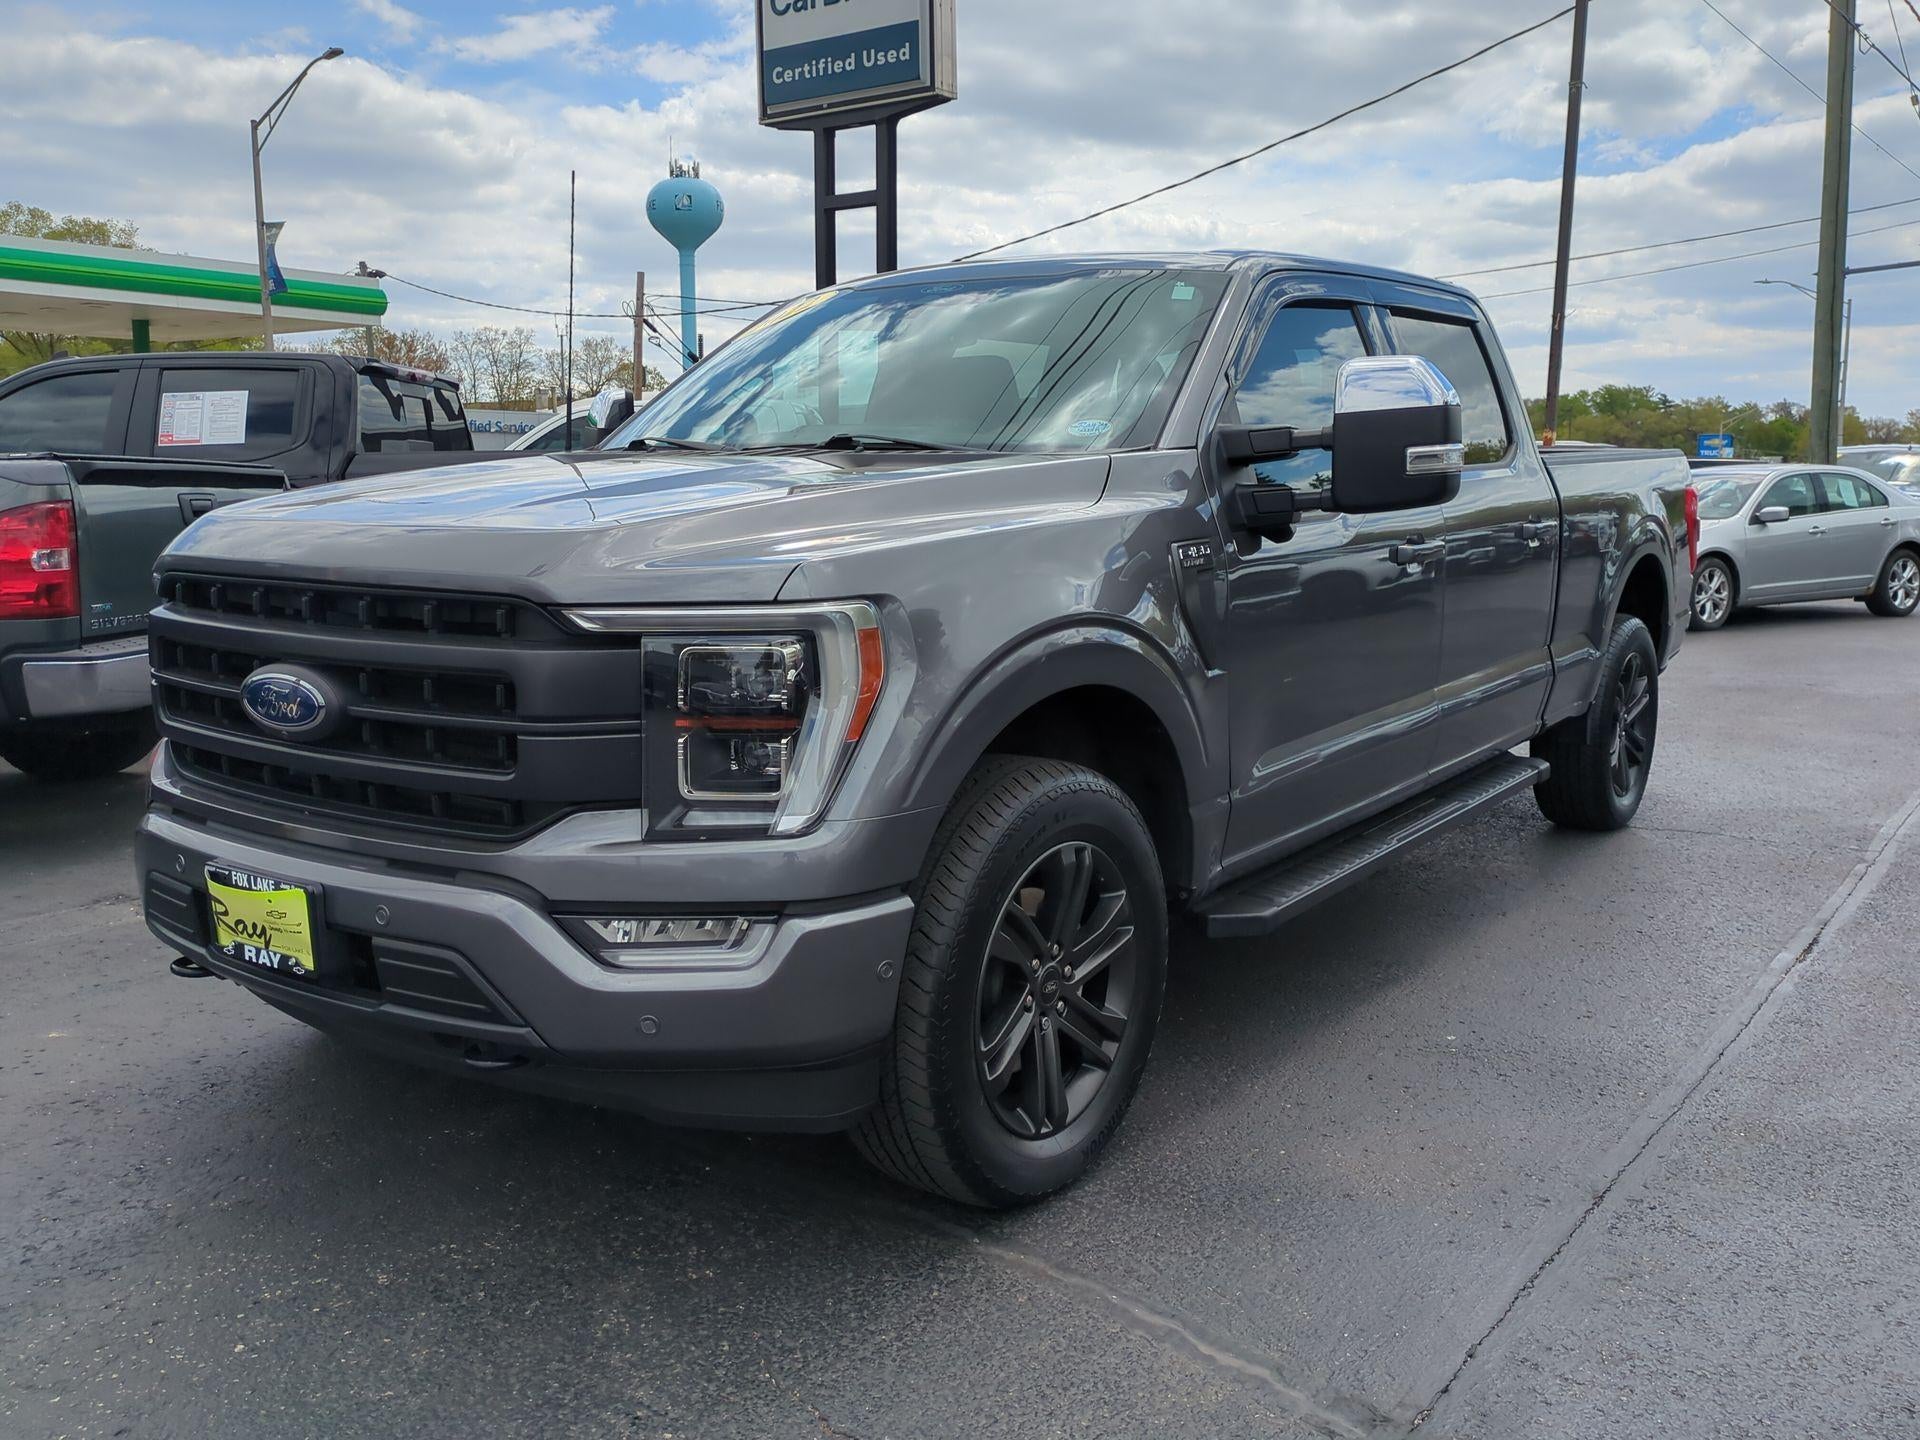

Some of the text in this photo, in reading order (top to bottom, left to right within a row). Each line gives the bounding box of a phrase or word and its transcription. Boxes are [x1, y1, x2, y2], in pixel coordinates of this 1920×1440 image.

[772, 42, 910, 84] Certified Used
[495, 420, 536, 433] Service
[257, 684, 301, 719] Ford
[231, 870, 249, 889] FOX
[250, 875, 275, 892] LAKE
[208, 893, 273, 950] Ray
[244, 944, 282, 969] RAY
